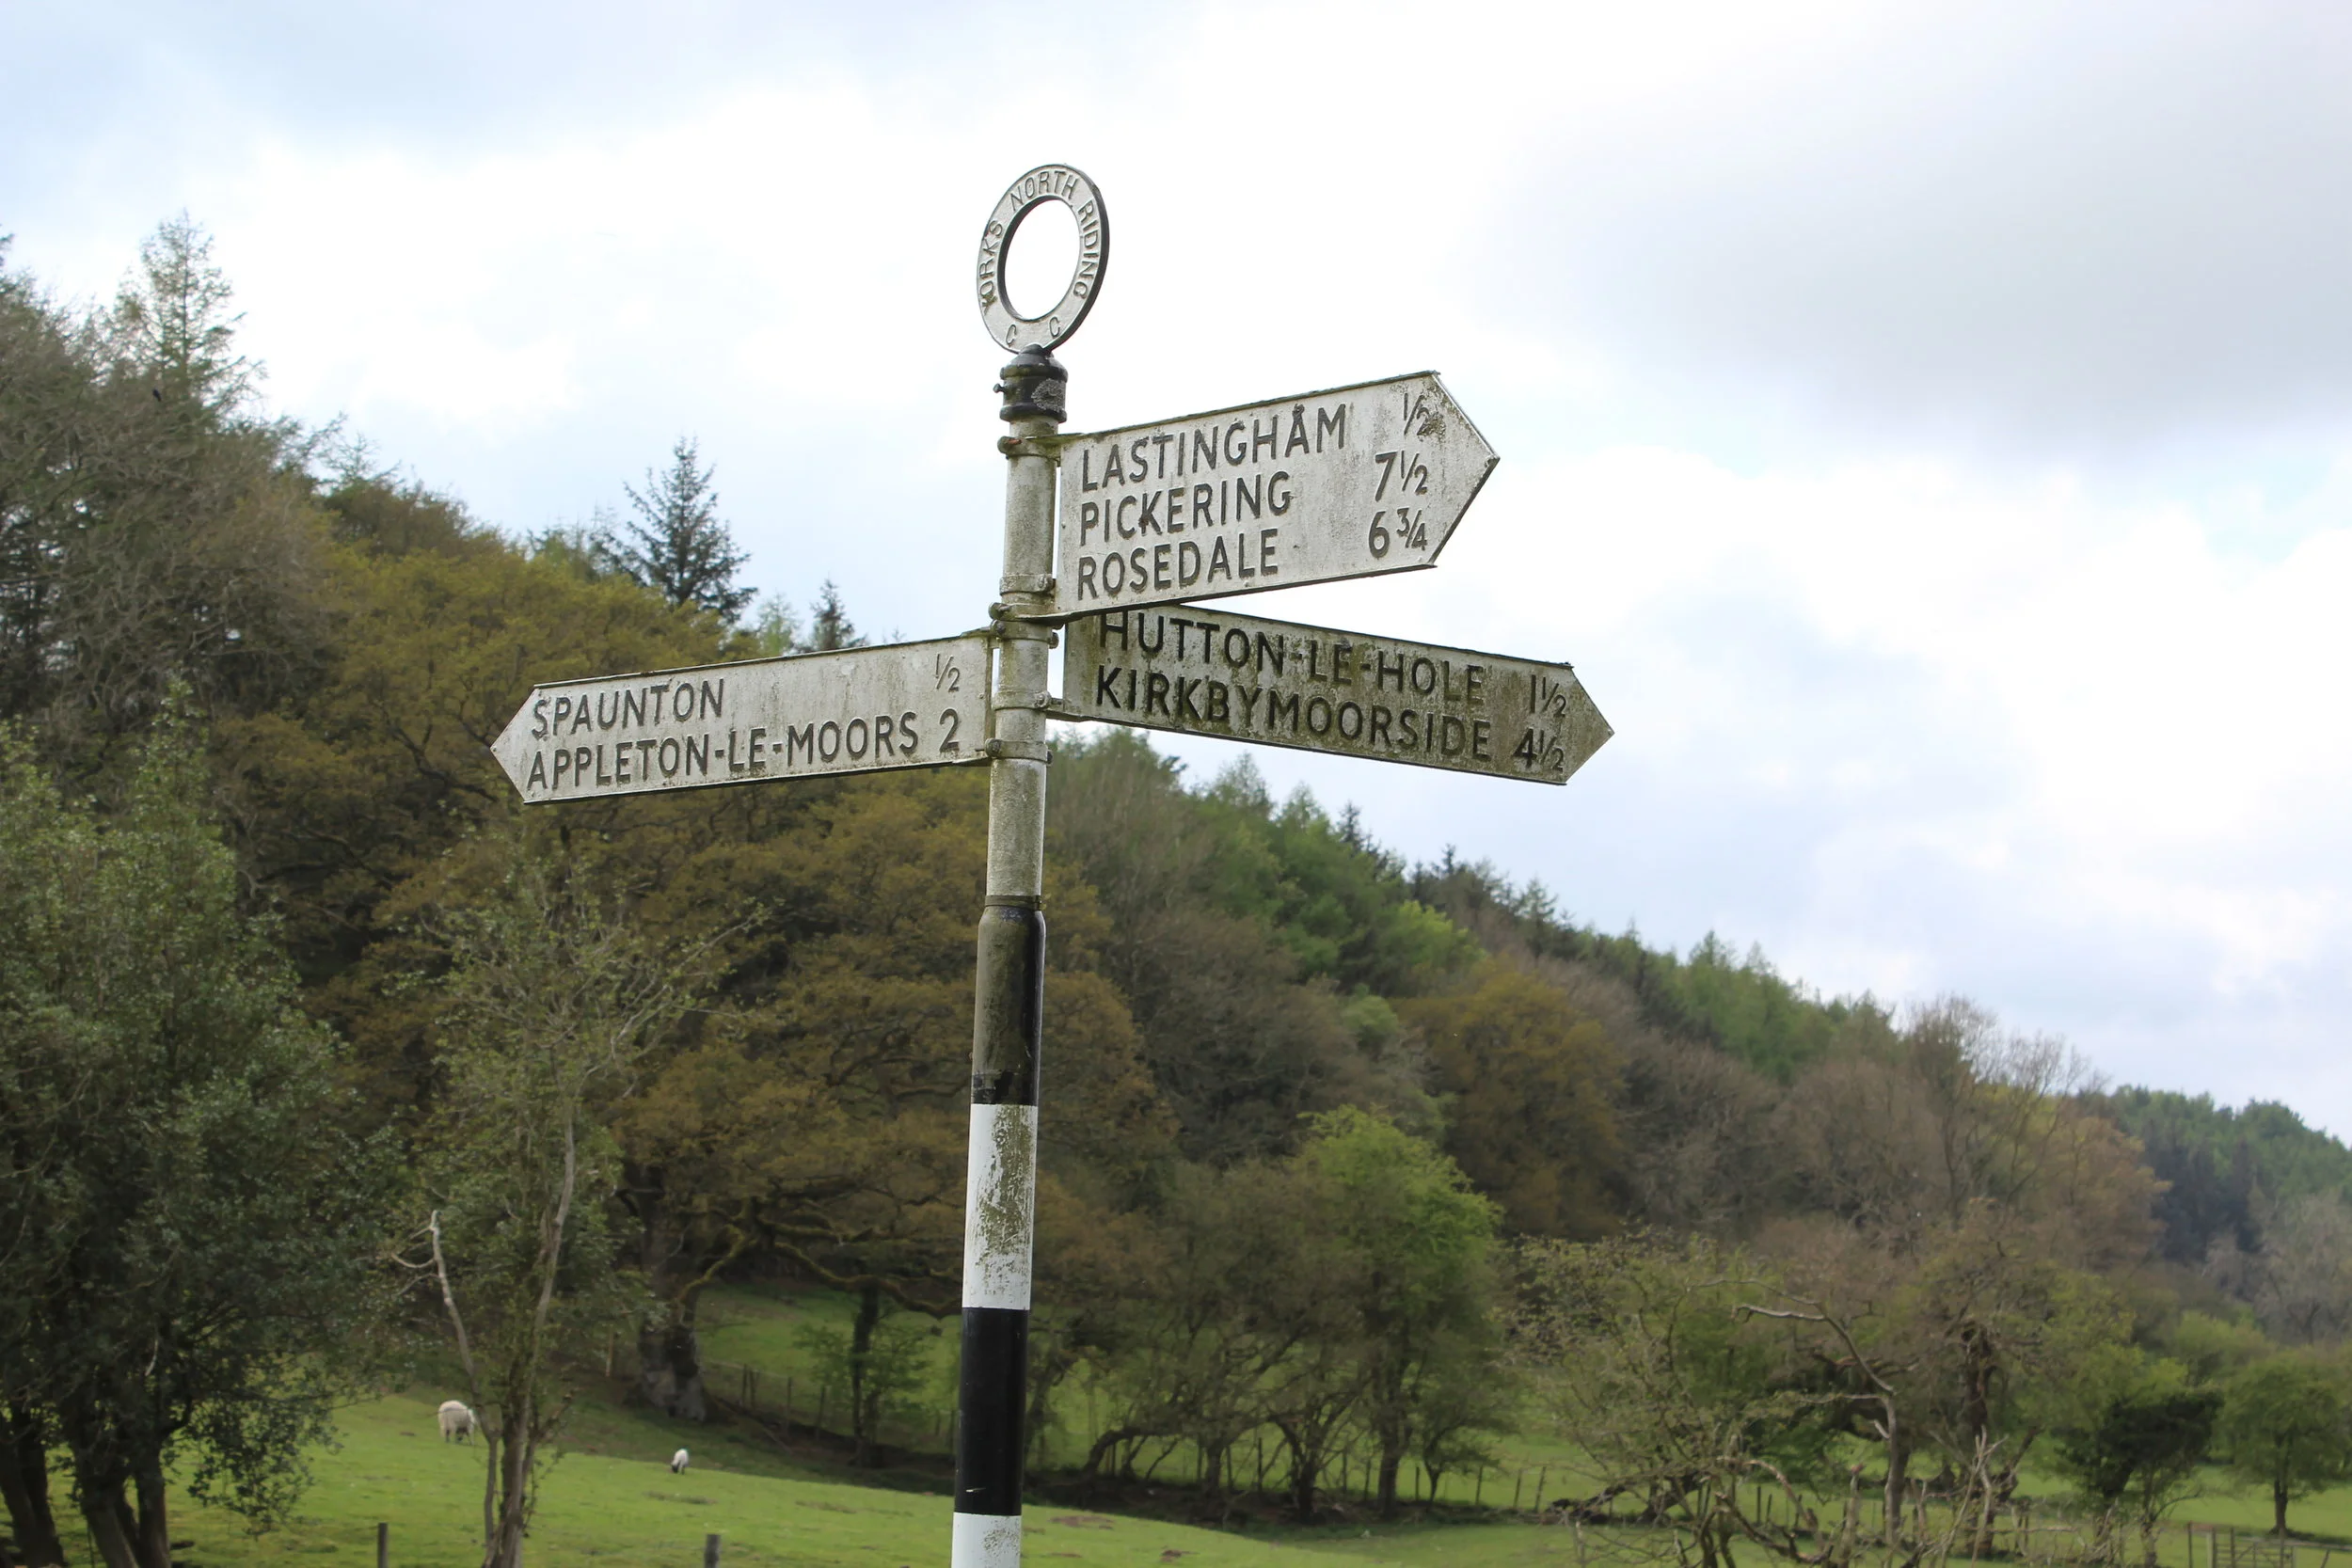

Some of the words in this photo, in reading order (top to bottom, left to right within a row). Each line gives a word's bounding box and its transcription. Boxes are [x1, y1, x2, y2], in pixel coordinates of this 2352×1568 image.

[979, 219, 1004, 315] YORKS
[1010, 169, 1079, 213] NORTH
[1073, 199, 1099, 299] RIDING
[1006, 324, 1017, 347] C
[1049, 316, 1061, 338] C
[1082, 403, 1347, 493] LASTINGHAM
[1080, 470, 1292, 546] PICKERING
[1077, 529, 1279, 601] ROSEDALE
[1099, 610, 1485, 707] HUTTON-LE-HOLE
[527, 711, 919, 790] APPLETON-LE-MOORS
[939, 708, 960, 752] 2
[532, 678, 724, 739] SPAUNTON
[1097, 664, 1492, 762] KIRKBYMOORSIDE
